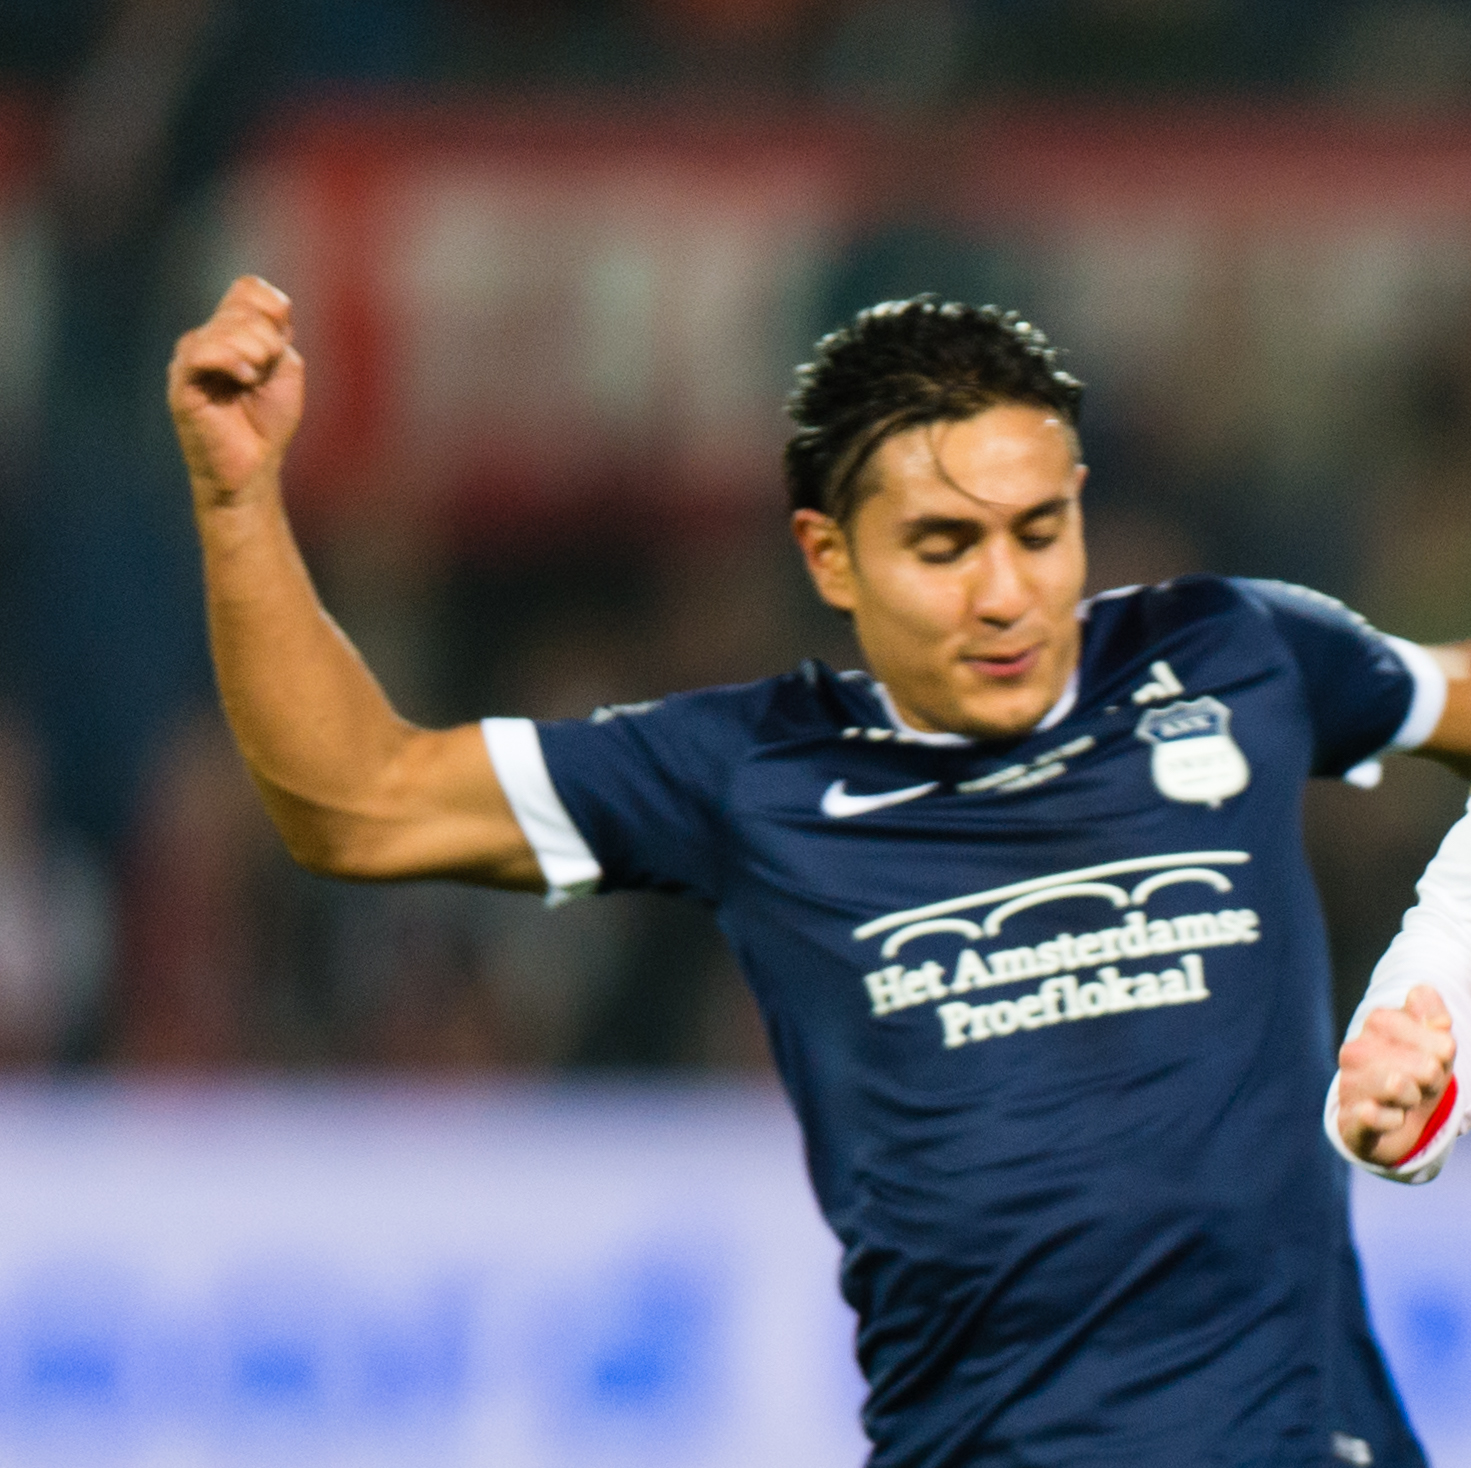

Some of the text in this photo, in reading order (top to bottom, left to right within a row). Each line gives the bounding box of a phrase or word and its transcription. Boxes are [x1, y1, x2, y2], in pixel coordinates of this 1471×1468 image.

[864, 909, 1261, 1016] Het Amsterdamse
[937, 954, 1211, 1049] Proeflokaal
